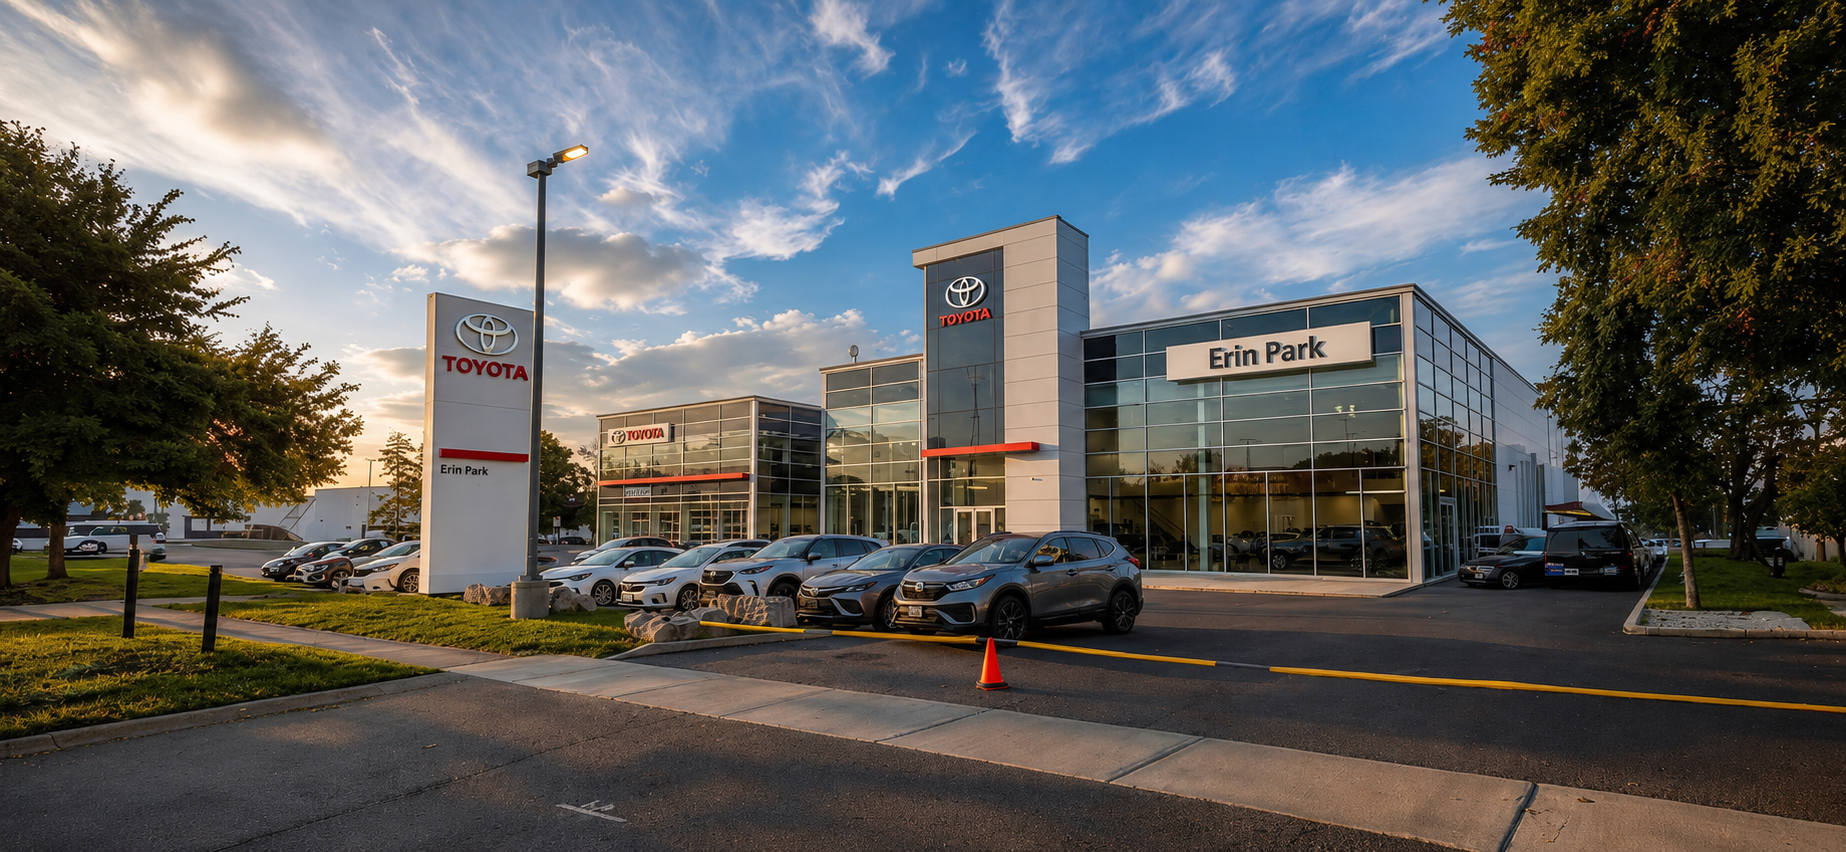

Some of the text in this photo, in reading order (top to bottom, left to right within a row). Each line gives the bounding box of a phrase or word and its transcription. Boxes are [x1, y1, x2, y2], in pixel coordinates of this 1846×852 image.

[939, 307, 991, 327] TOYOTA
[1209, 335, 1328, 370] Erin Park
[442, 355, 529, 381] TOYOTA
[626, 427, 665, 441] TOYOTA
[440, 464, 489, 476] Erin Park
